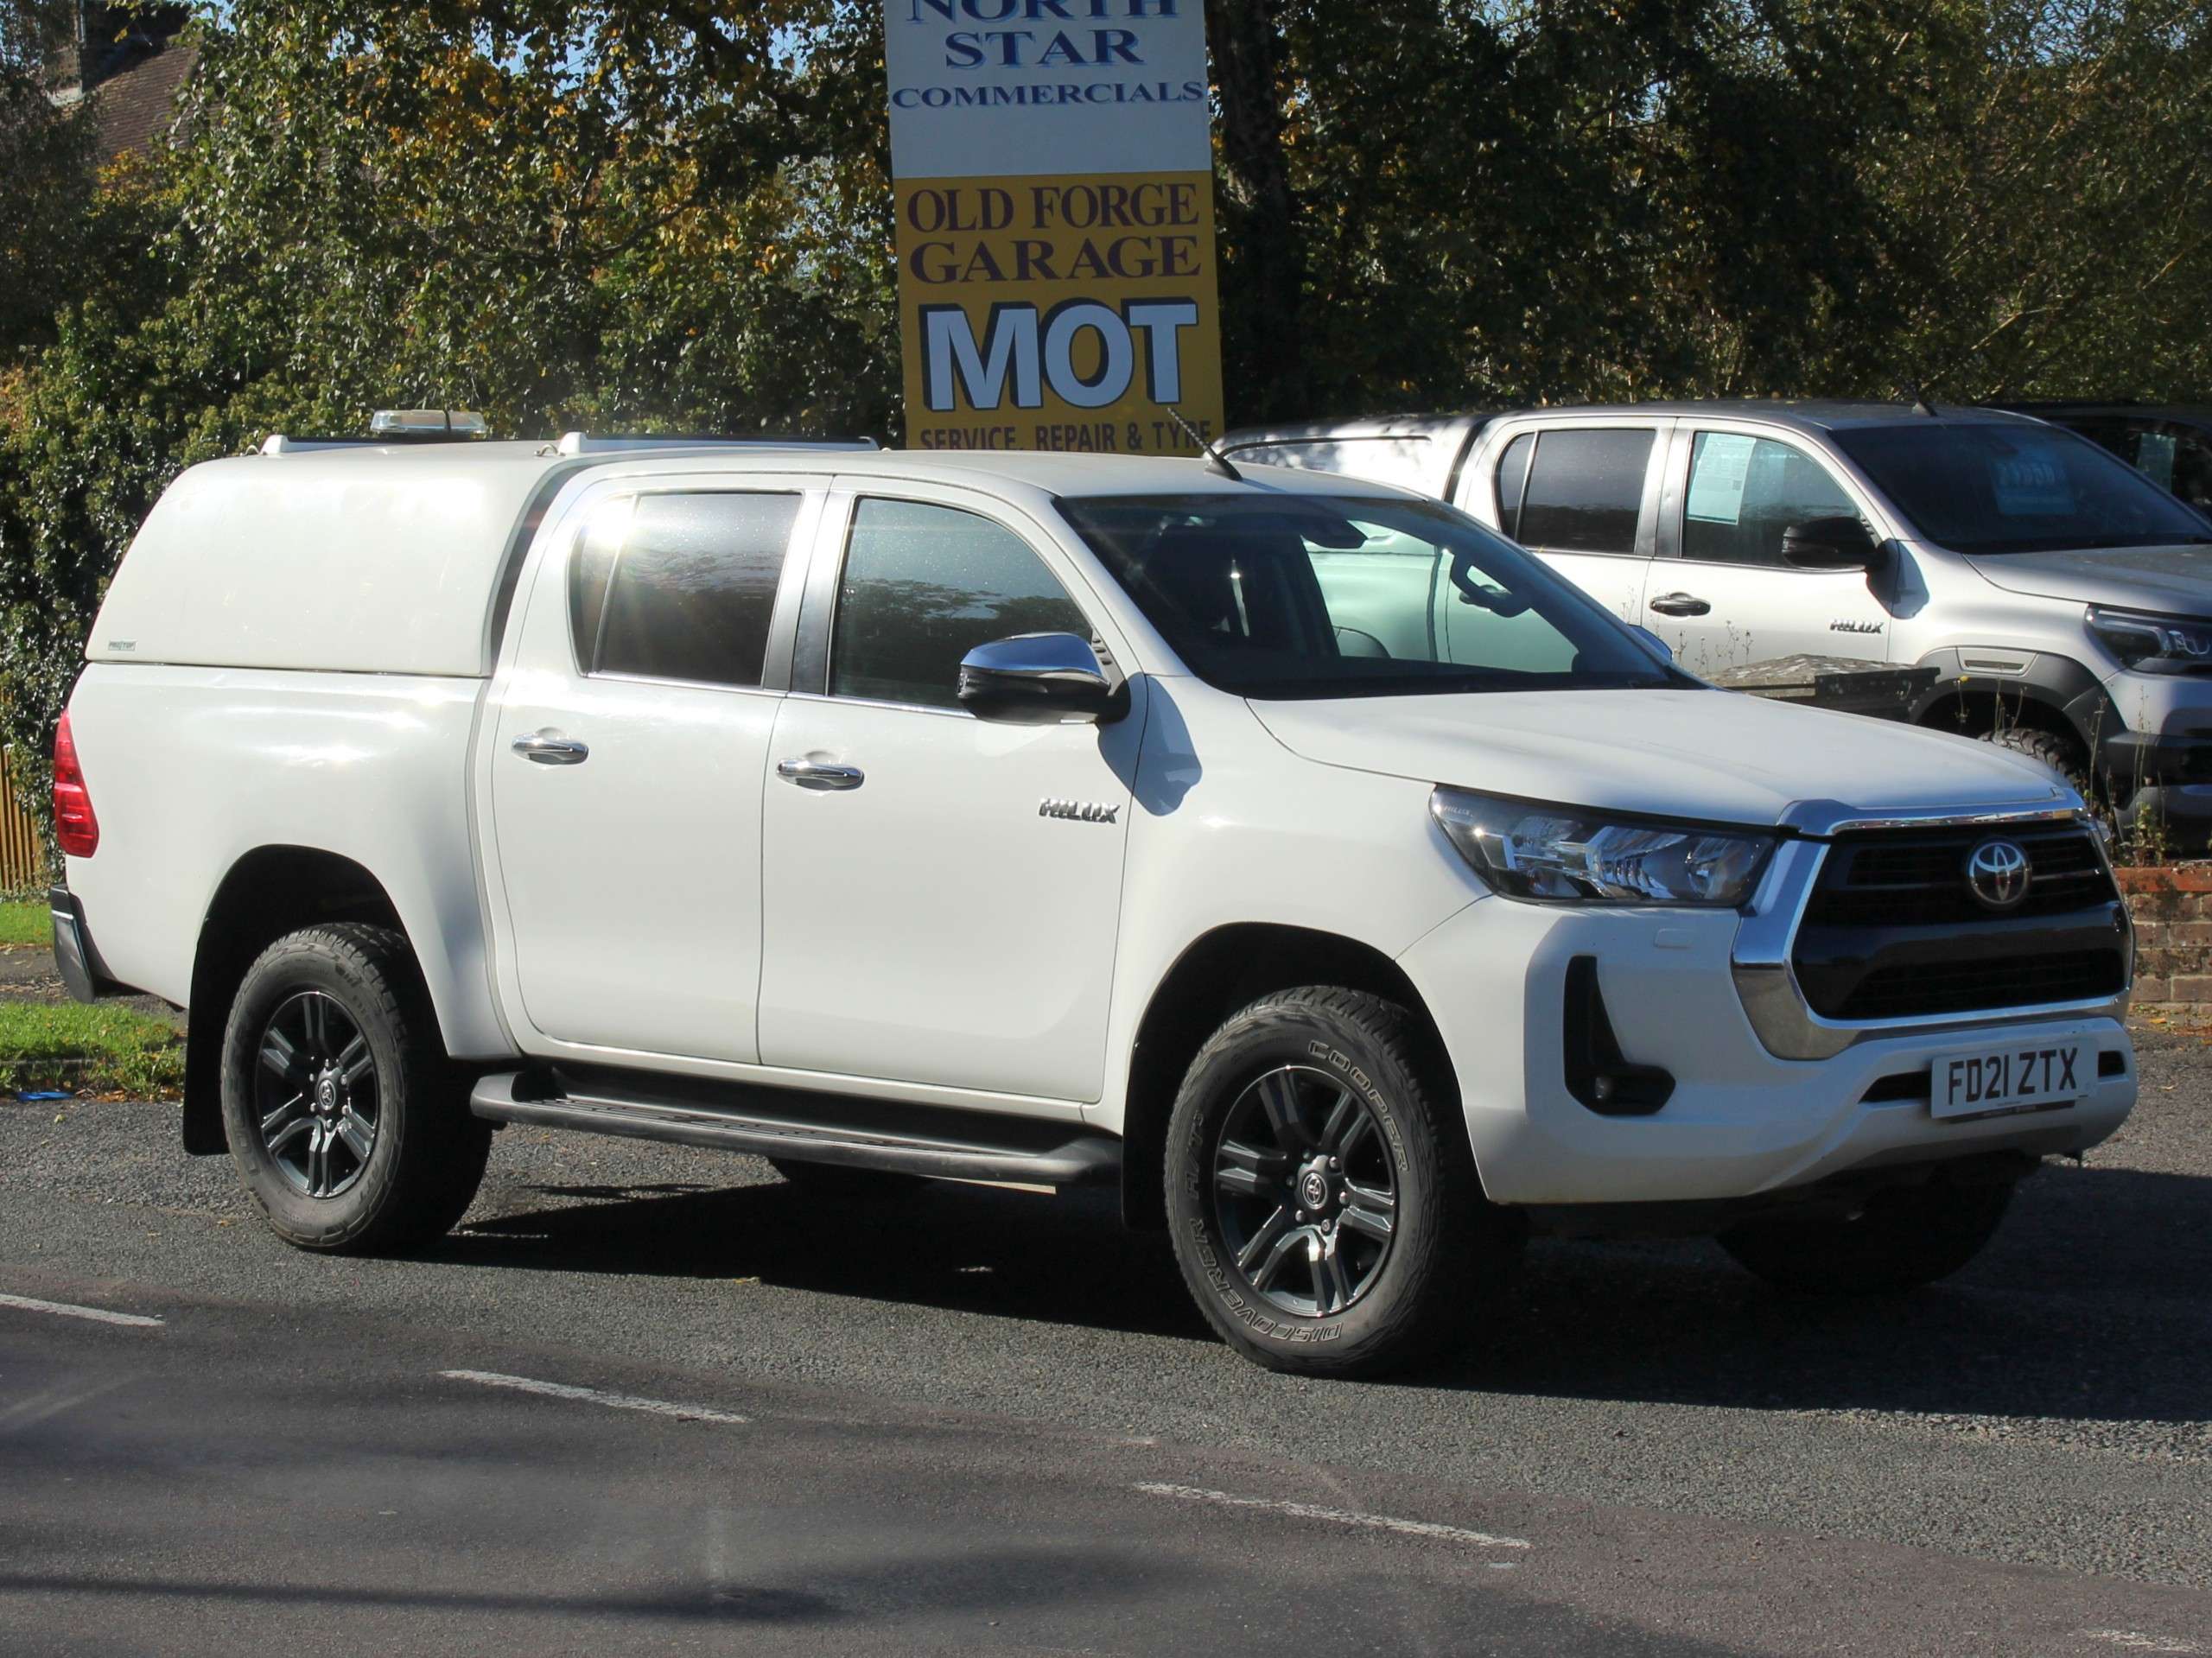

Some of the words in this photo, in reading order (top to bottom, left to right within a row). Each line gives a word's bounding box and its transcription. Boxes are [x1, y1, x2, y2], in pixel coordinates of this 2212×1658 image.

[945, 29, 1145, 68] STAR
[893, 82, 1204, 109] COMMERCIALS
[907, 188, 1014, 232] OLD
[1031, 183, 1199, 230] FORGE
[910, 235, 1201, 284] GARAGE
[918, 296, 1198, 412] MOT
[1035, 423, 1117, 452] REPAIR
[1127, 422, 1142, 450] &
[1039, 797, 1121, 824] HILUX
[1948, 1054, 2010, 1105] FD21
[2018, 1047, 2077, 1096] ZTX
[1308, 1039, 1409, 1171] COOPER
[1189, 1217, 1344, 1342] DISCOVERER
